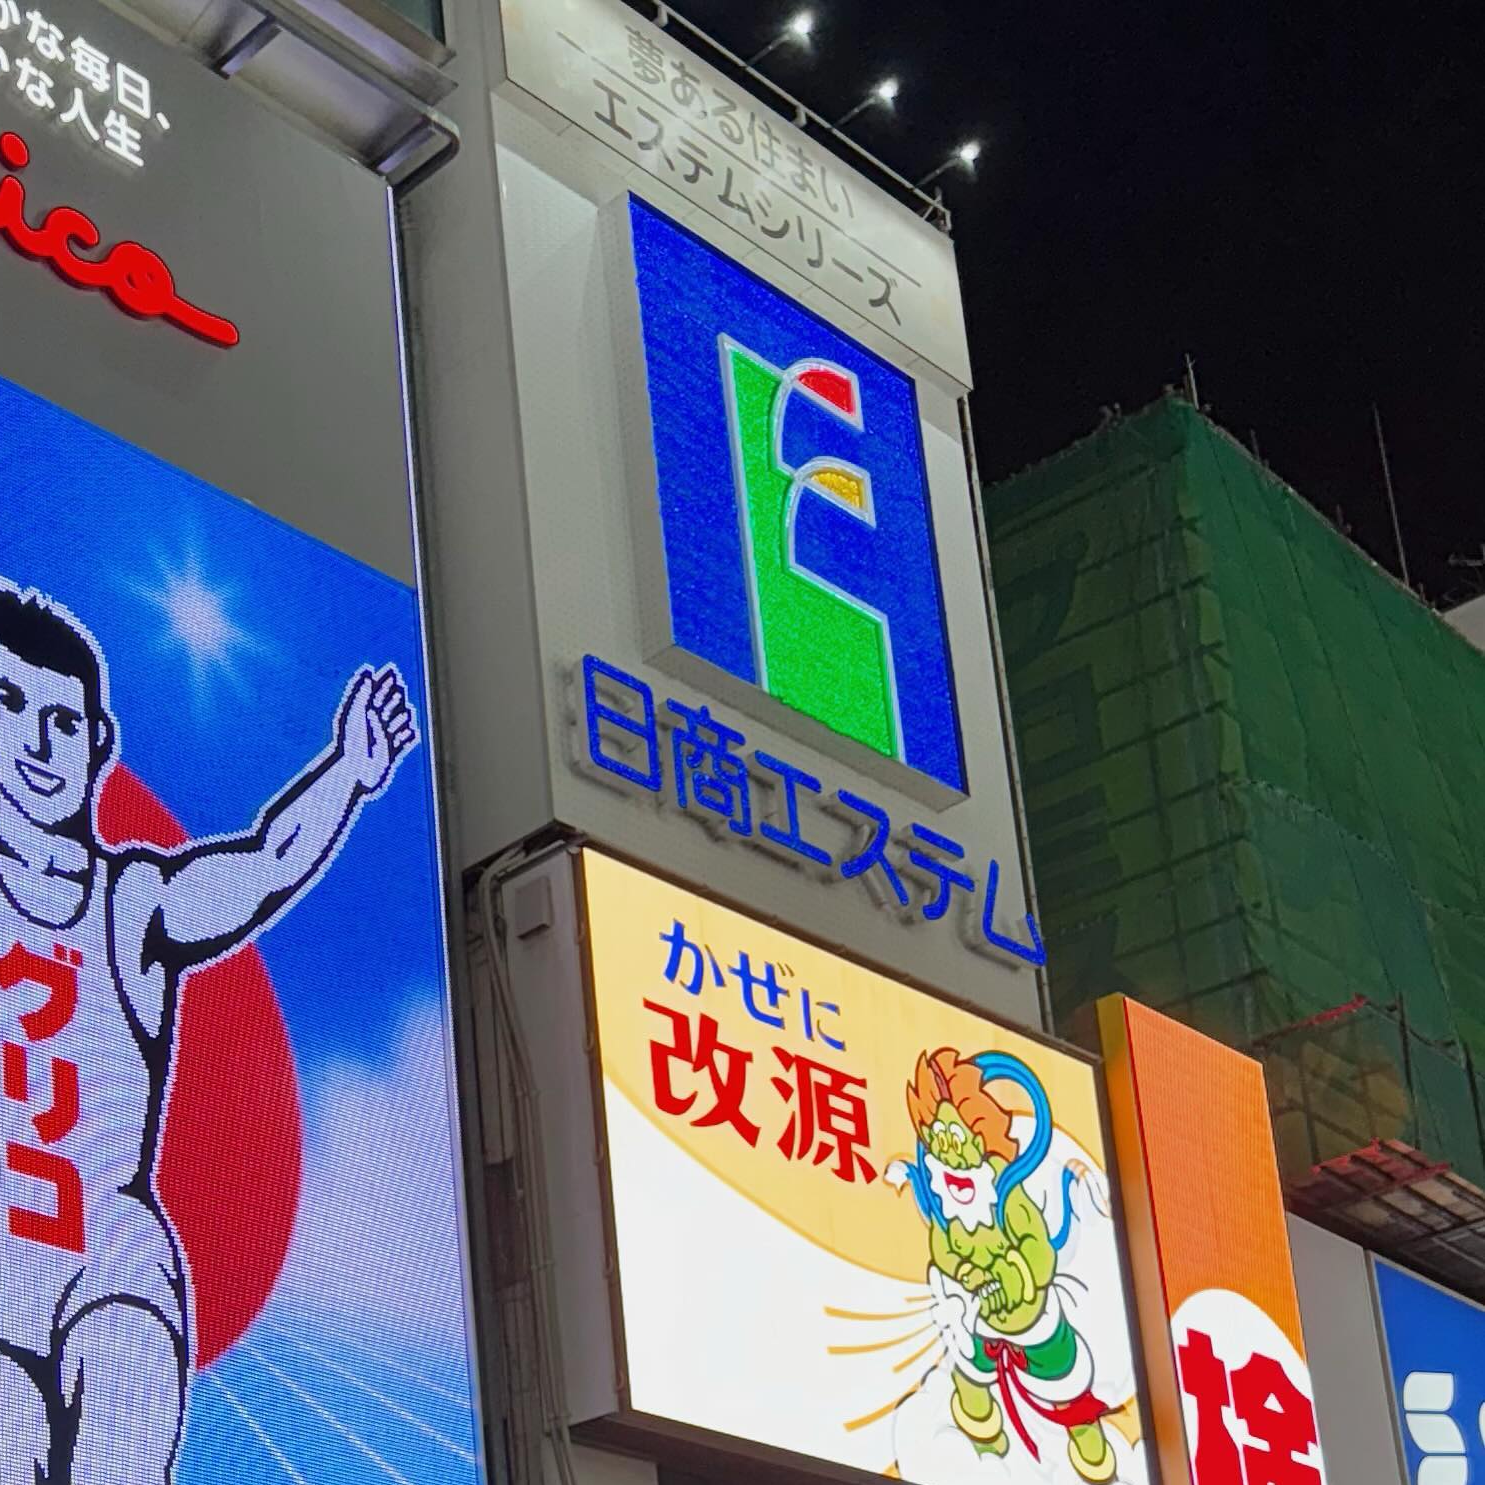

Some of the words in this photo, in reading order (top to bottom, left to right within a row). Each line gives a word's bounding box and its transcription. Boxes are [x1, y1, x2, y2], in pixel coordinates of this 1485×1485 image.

[593, 79, 901, 326] エステムシリーズ
[625, 26, 854, 218] 夢ある住まい
[583, 654, 1046, 966] 日商エステム
[660, 920, 846, 1051] かぜに
[643, 998, 877, 1186] 改源
